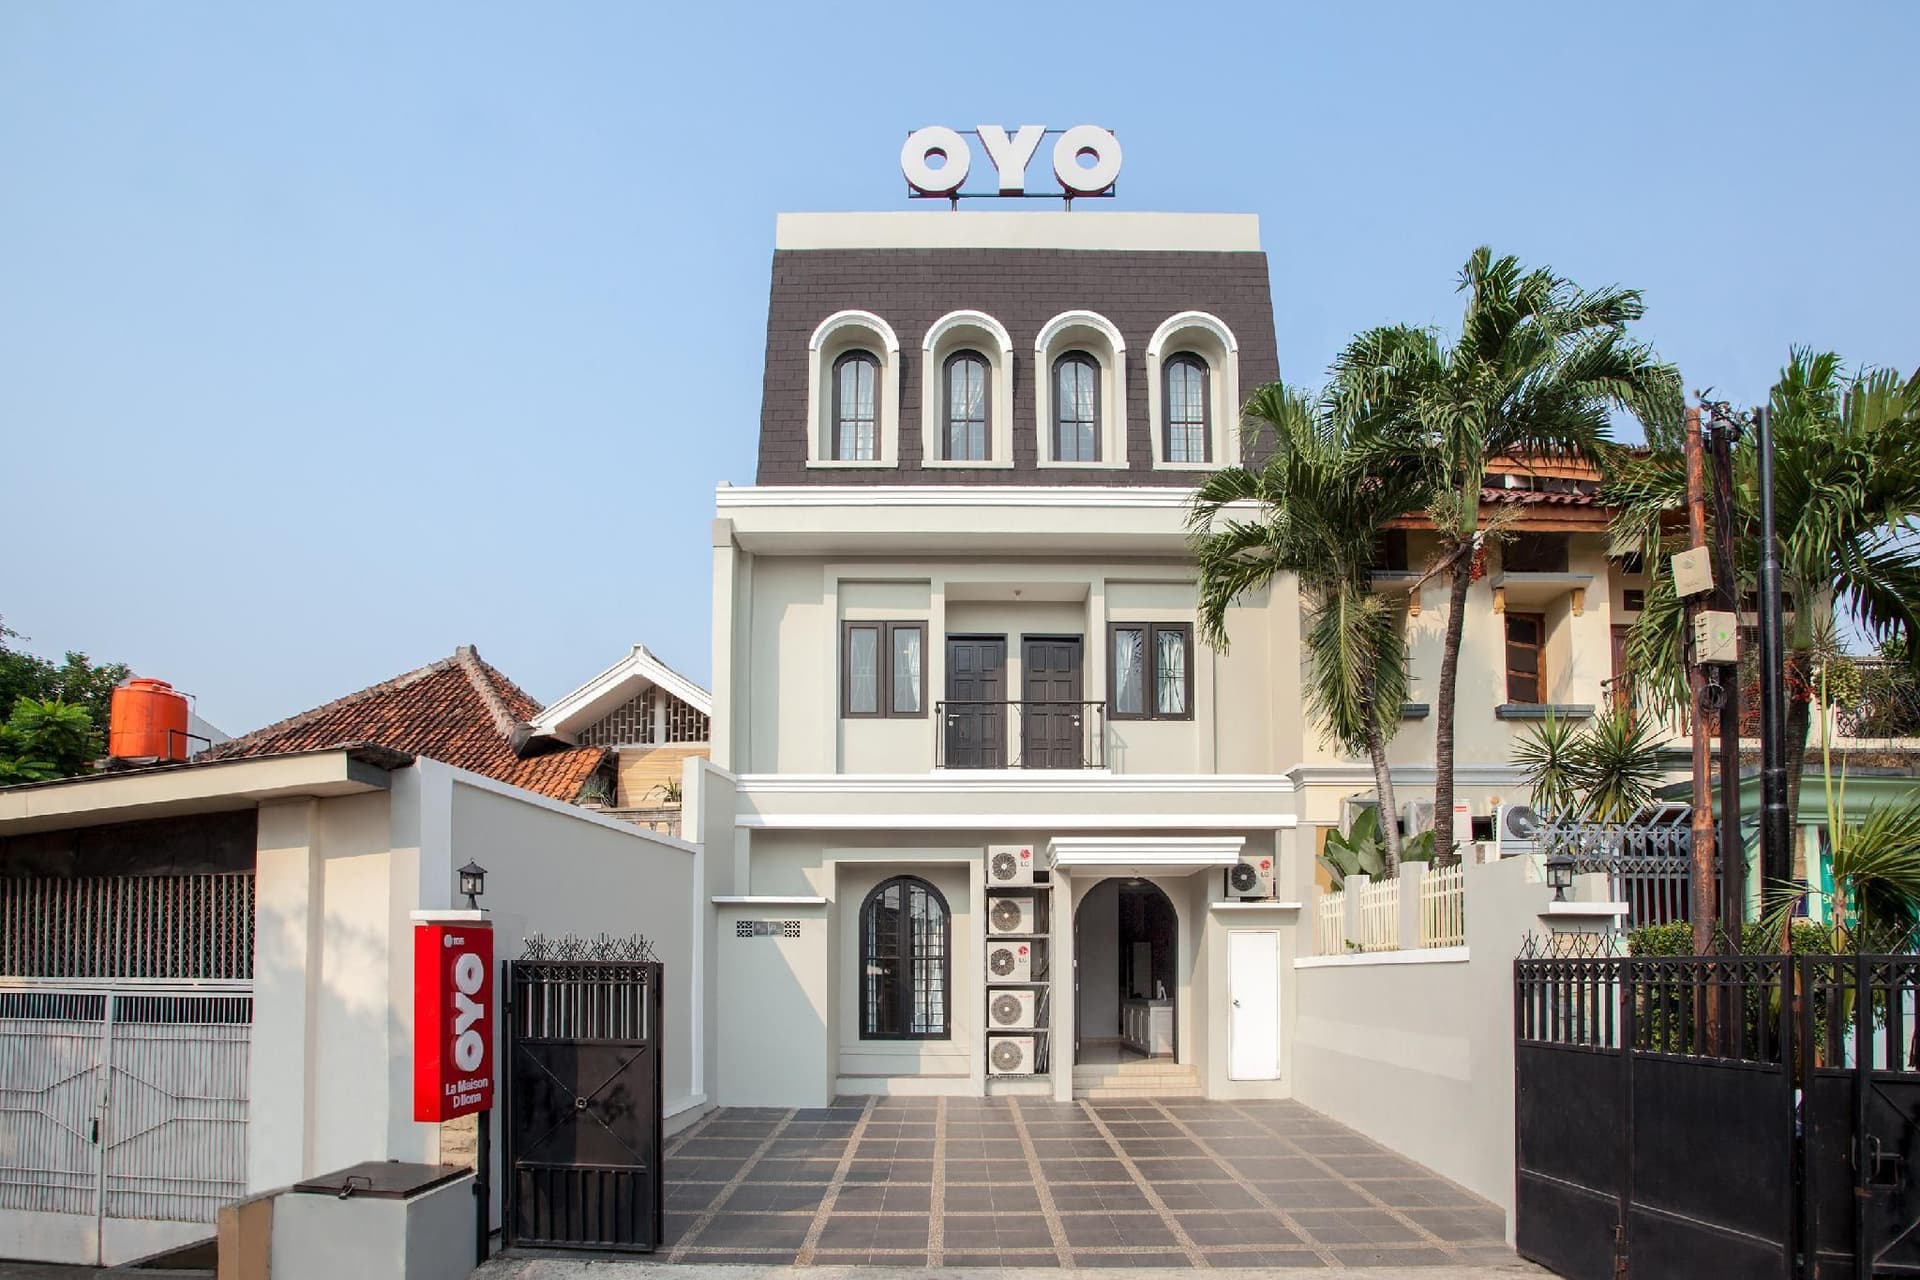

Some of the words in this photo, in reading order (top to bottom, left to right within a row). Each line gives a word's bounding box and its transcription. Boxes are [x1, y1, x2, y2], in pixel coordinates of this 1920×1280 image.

[901, 125, 1122, 193] OYO
[455, 953, 484, 1072] OYO
[445, 1083, 457, 1096] La
[457, 1078, 489, 1093] Maison
